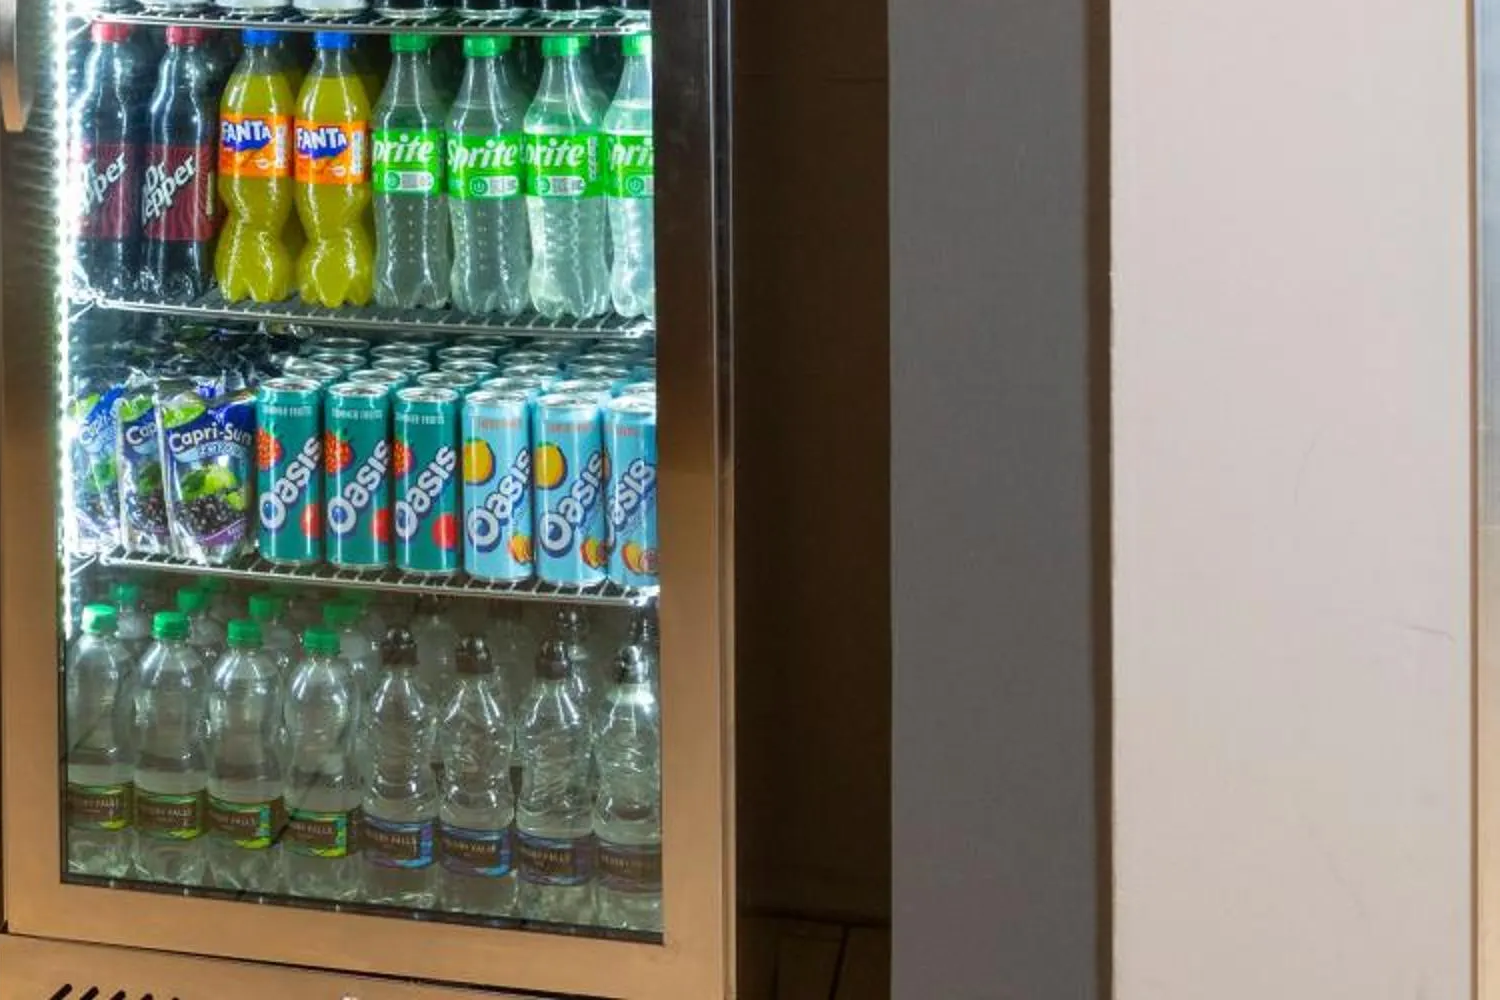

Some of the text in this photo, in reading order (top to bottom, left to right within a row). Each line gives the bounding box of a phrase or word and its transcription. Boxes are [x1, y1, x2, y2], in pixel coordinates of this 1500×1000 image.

[220, 120, 272, 143] FANTA
[296, 125, 348, 150] FANTA
[371, 133, 435, 168] prite
[447, 138, 518, 174] Sprite
[523, 136, 586, 168] prite
[145, 160, 166, 194] Dr
[168, 421, 252, 452] Capri-Sun
[259, 437, 322, 530] Oasis
[327, 439, 391, 534] Oasis
[394, 445, 457, 539] Oasis
[467, 450, 532, 550] Oasis
[607, 458, 656, 542] asis
[539, 452, 604, 555] Oasis
